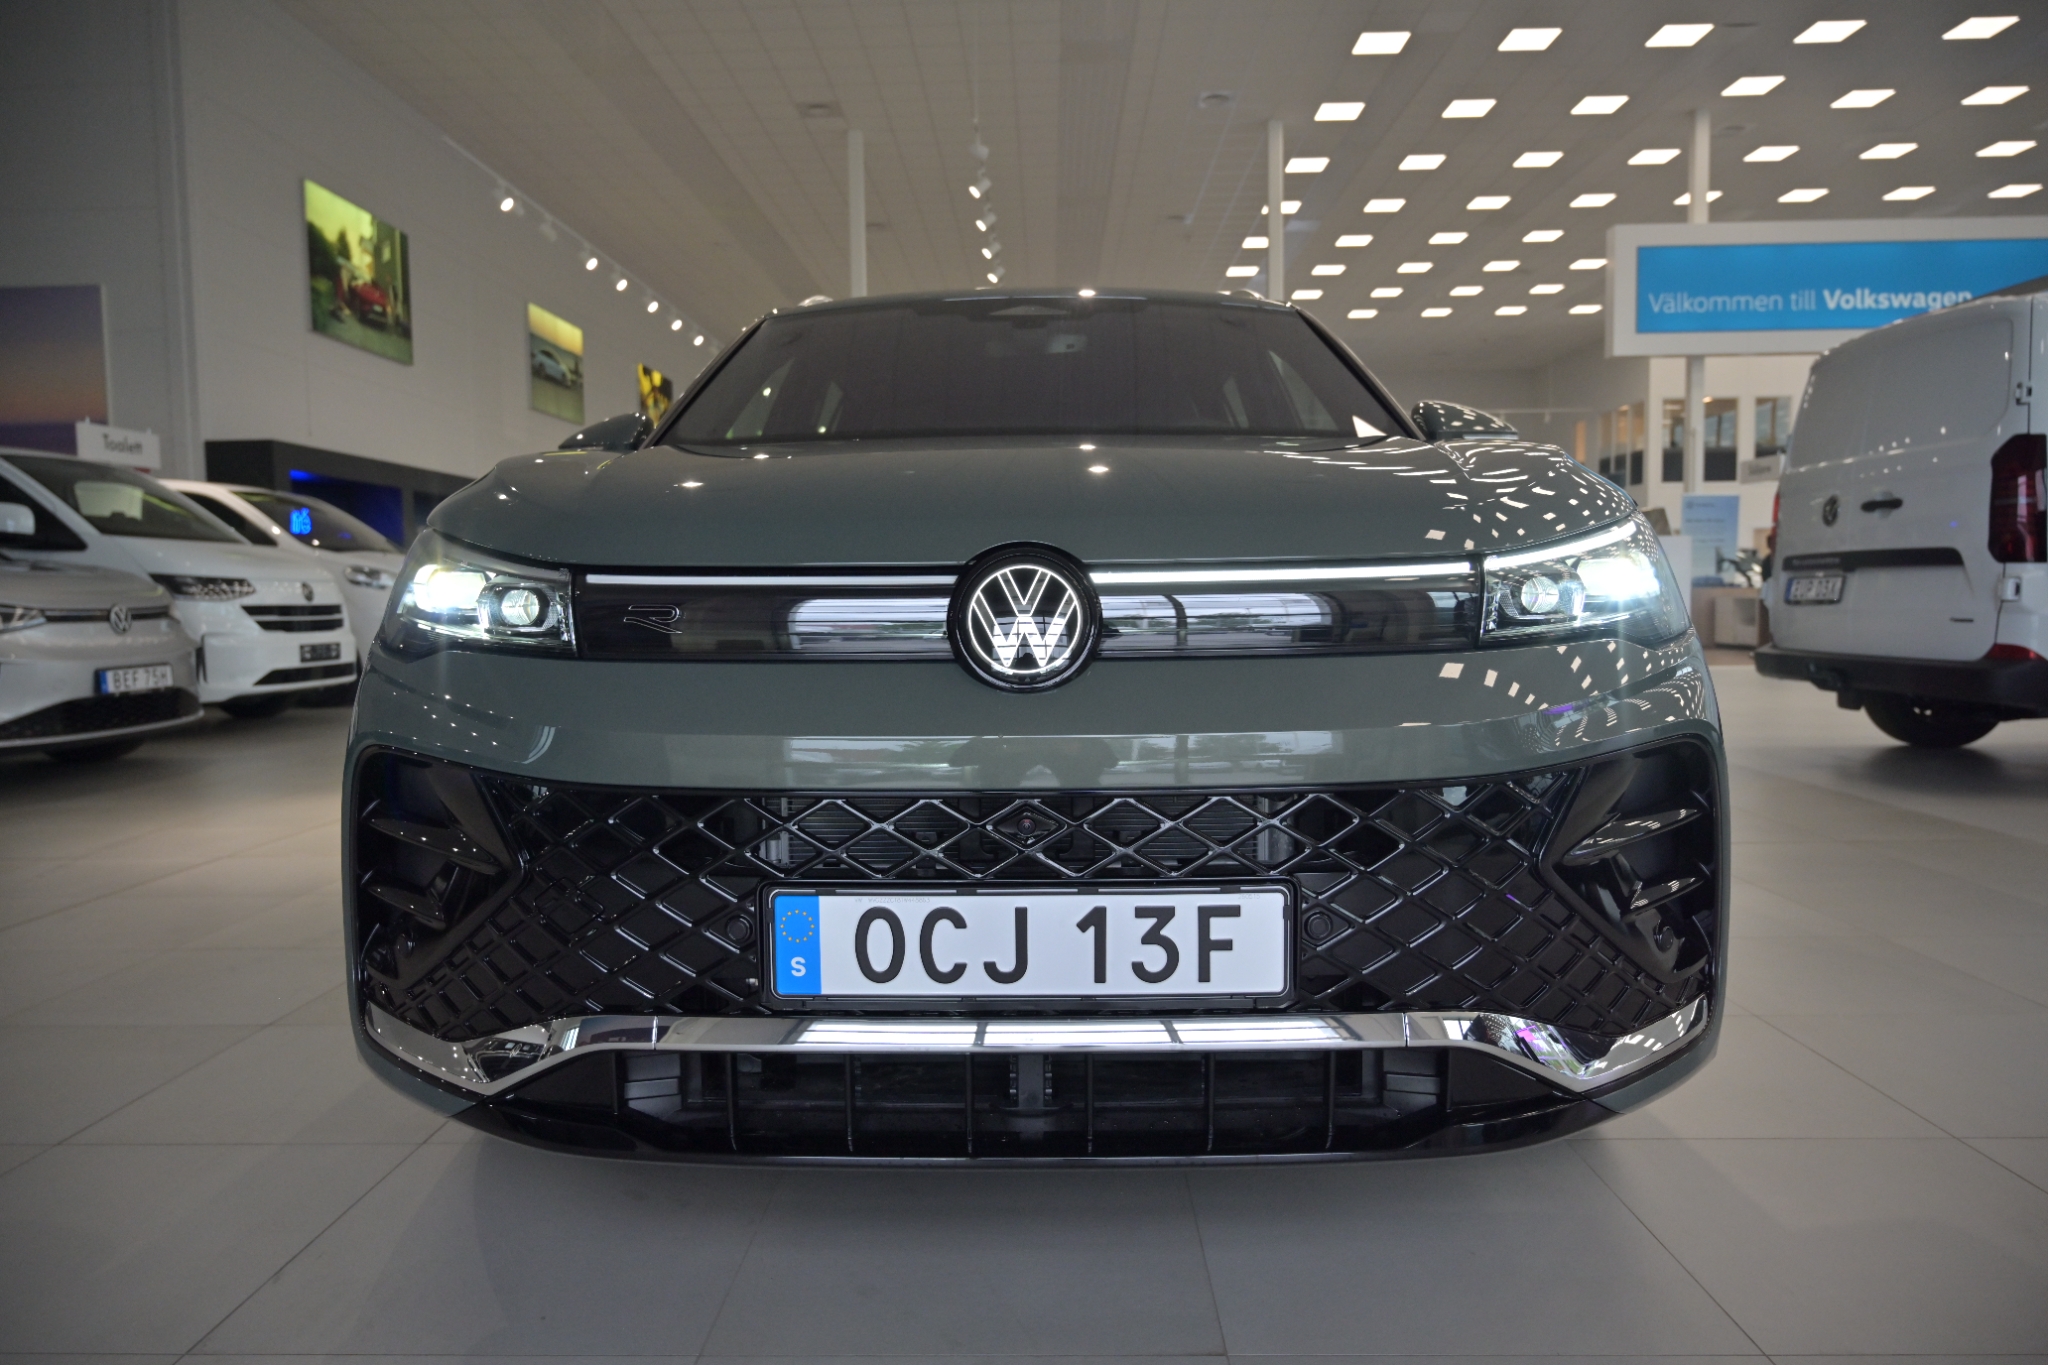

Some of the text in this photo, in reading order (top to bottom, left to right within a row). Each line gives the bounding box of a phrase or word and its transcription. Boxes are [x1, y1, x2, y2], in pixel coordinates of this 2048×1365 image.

[1649, 287, 1973, 314] Välkommen till Volkswagen
[102, 432, 143, 455] Toalett
[113, 668, 139, 690] BEF
[854, 904, 1241, 984] OCJ 13F
[790, 956, 807, 978] S
